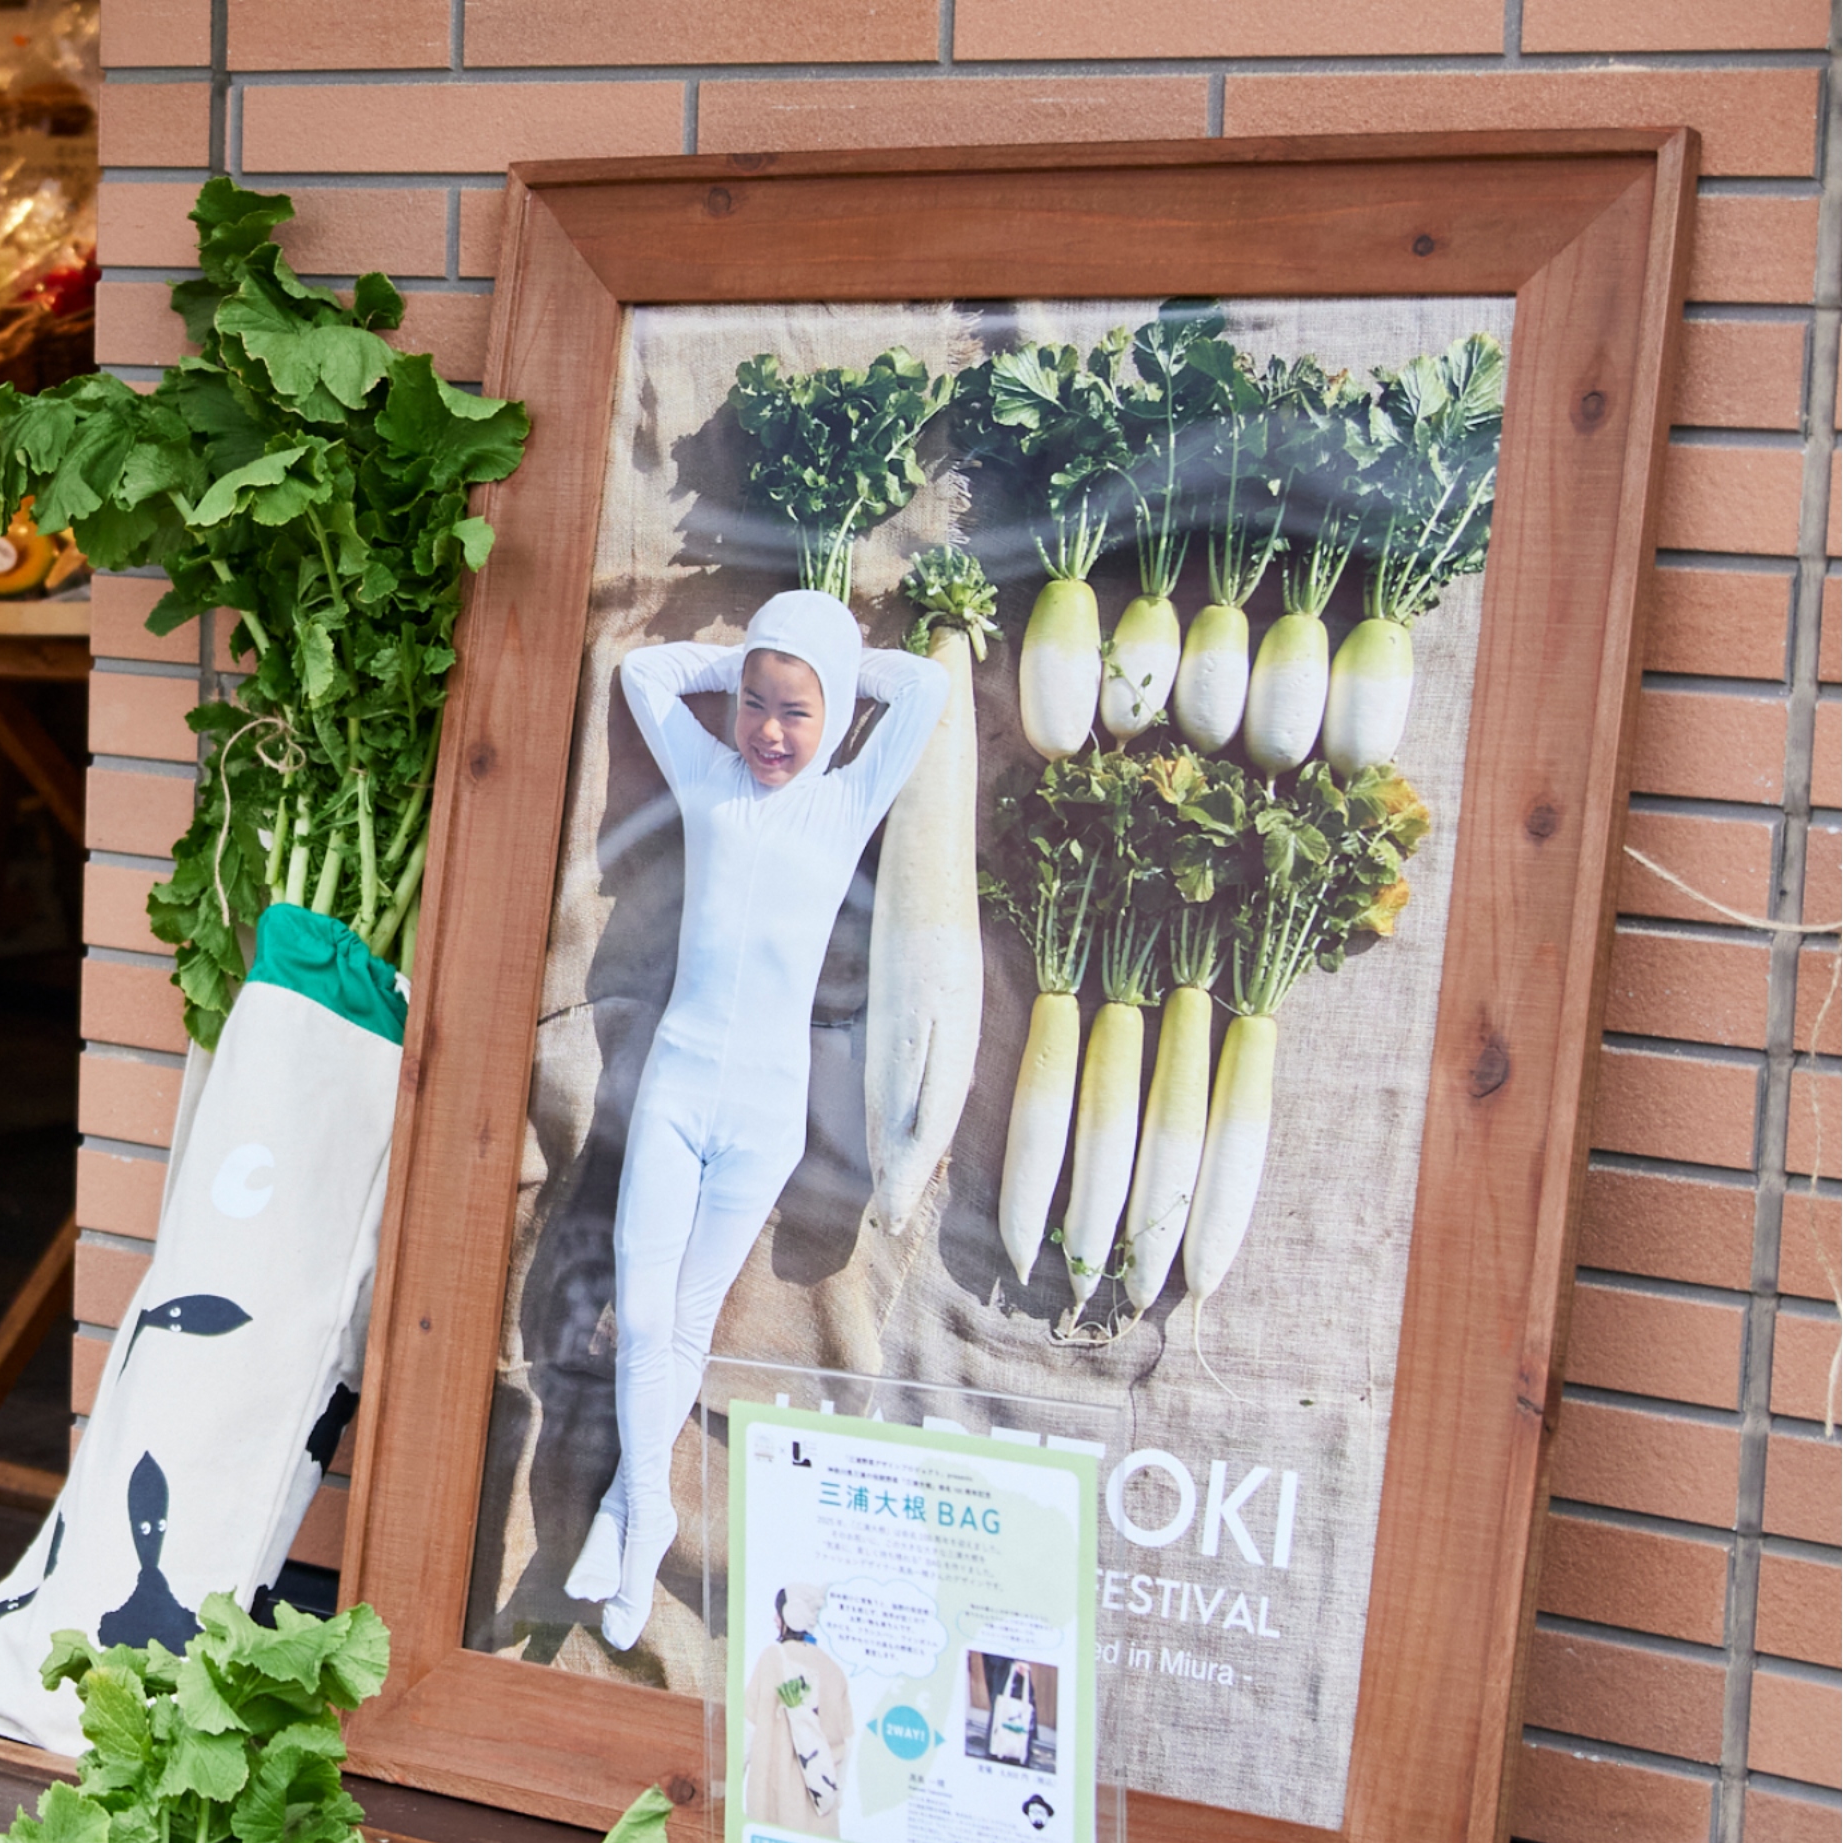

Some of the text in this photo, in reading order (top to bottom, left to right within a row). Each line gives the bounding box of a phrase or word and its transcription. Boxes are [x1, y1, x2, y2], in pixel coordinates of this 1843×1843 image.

[818, 1480, 1001, 1535] 三浦大根 BAG
[1128, 1642, 1151, 1670] in
[1159, 1647, 1234, 1687] Miura
[886, 1722, 926, 1743] 2WAY!
